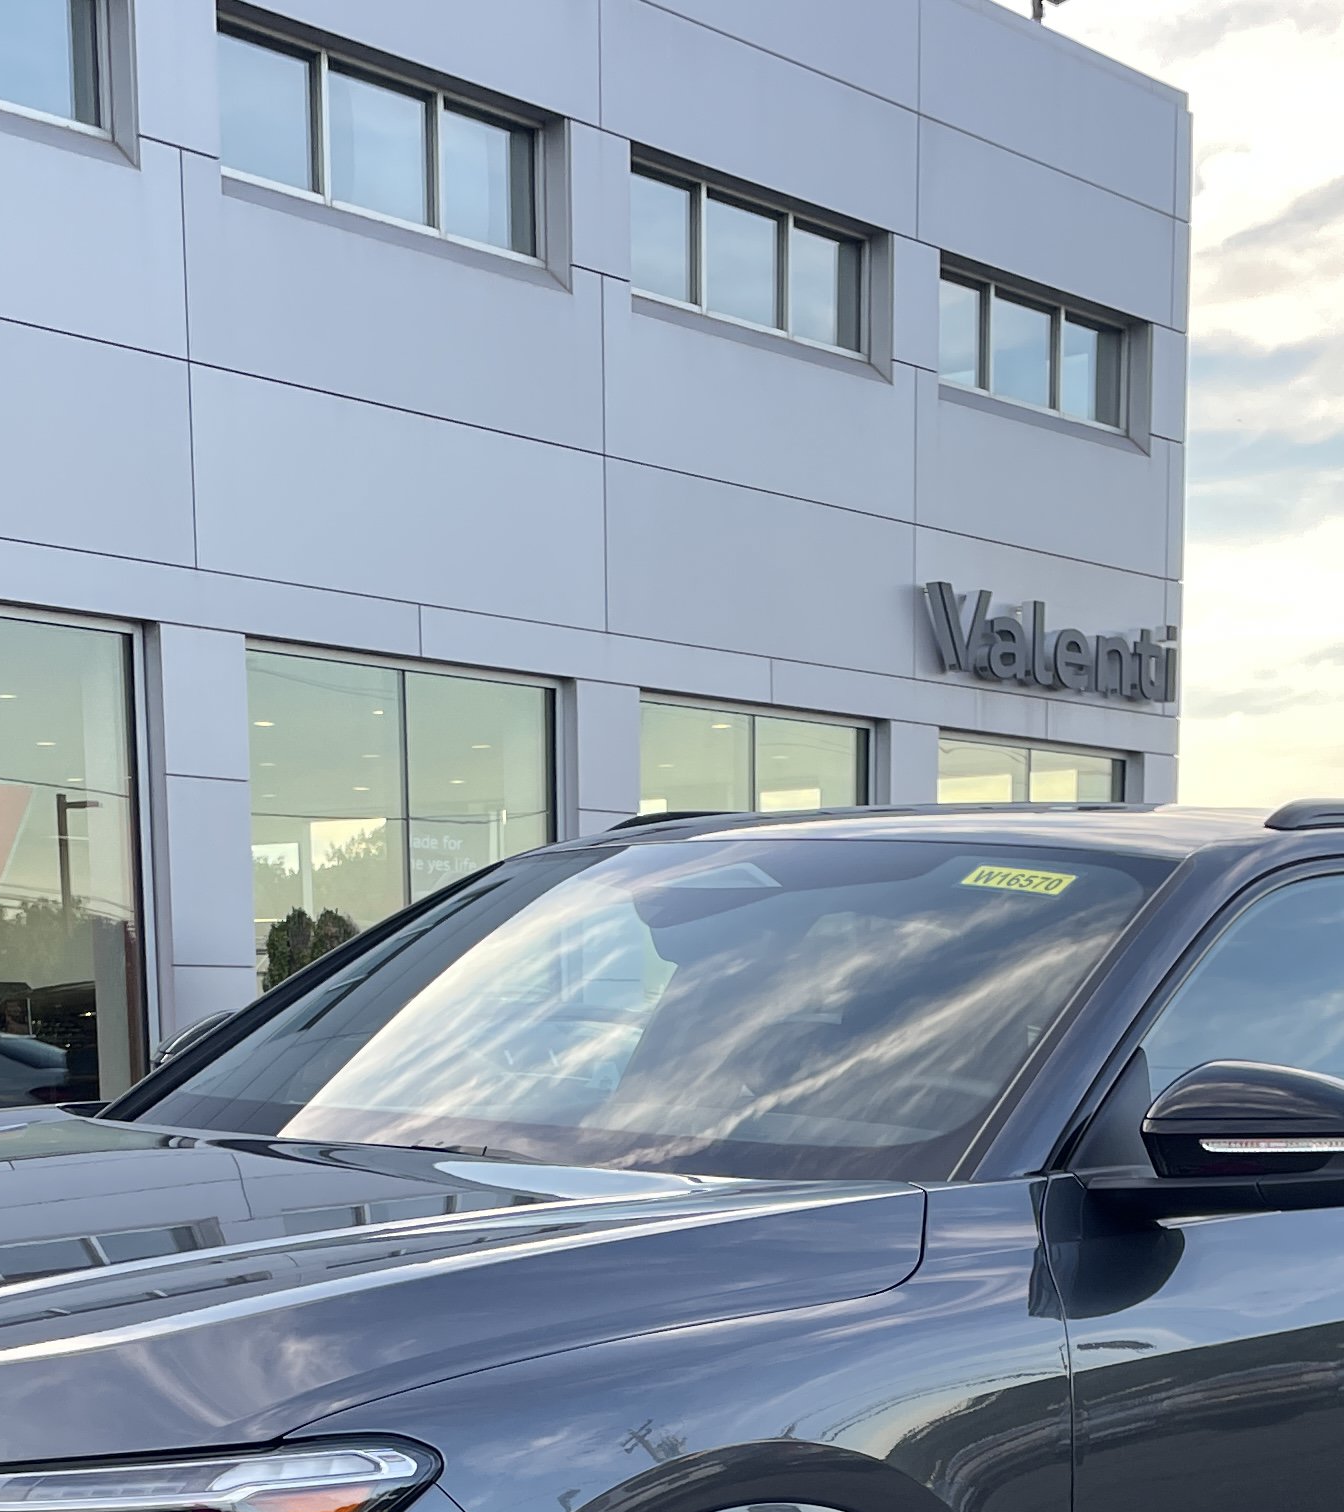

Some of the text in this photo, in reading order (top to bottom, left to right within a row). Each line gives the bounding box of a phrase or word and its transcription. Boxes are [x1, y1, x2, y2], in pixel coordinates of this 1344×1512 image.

[922, 581, 1177, 703] Valenti
[409, 835, 464, 850] ade for
[427, 859, 451, 874] yes
[972, 869, 1064, 892] W16570
